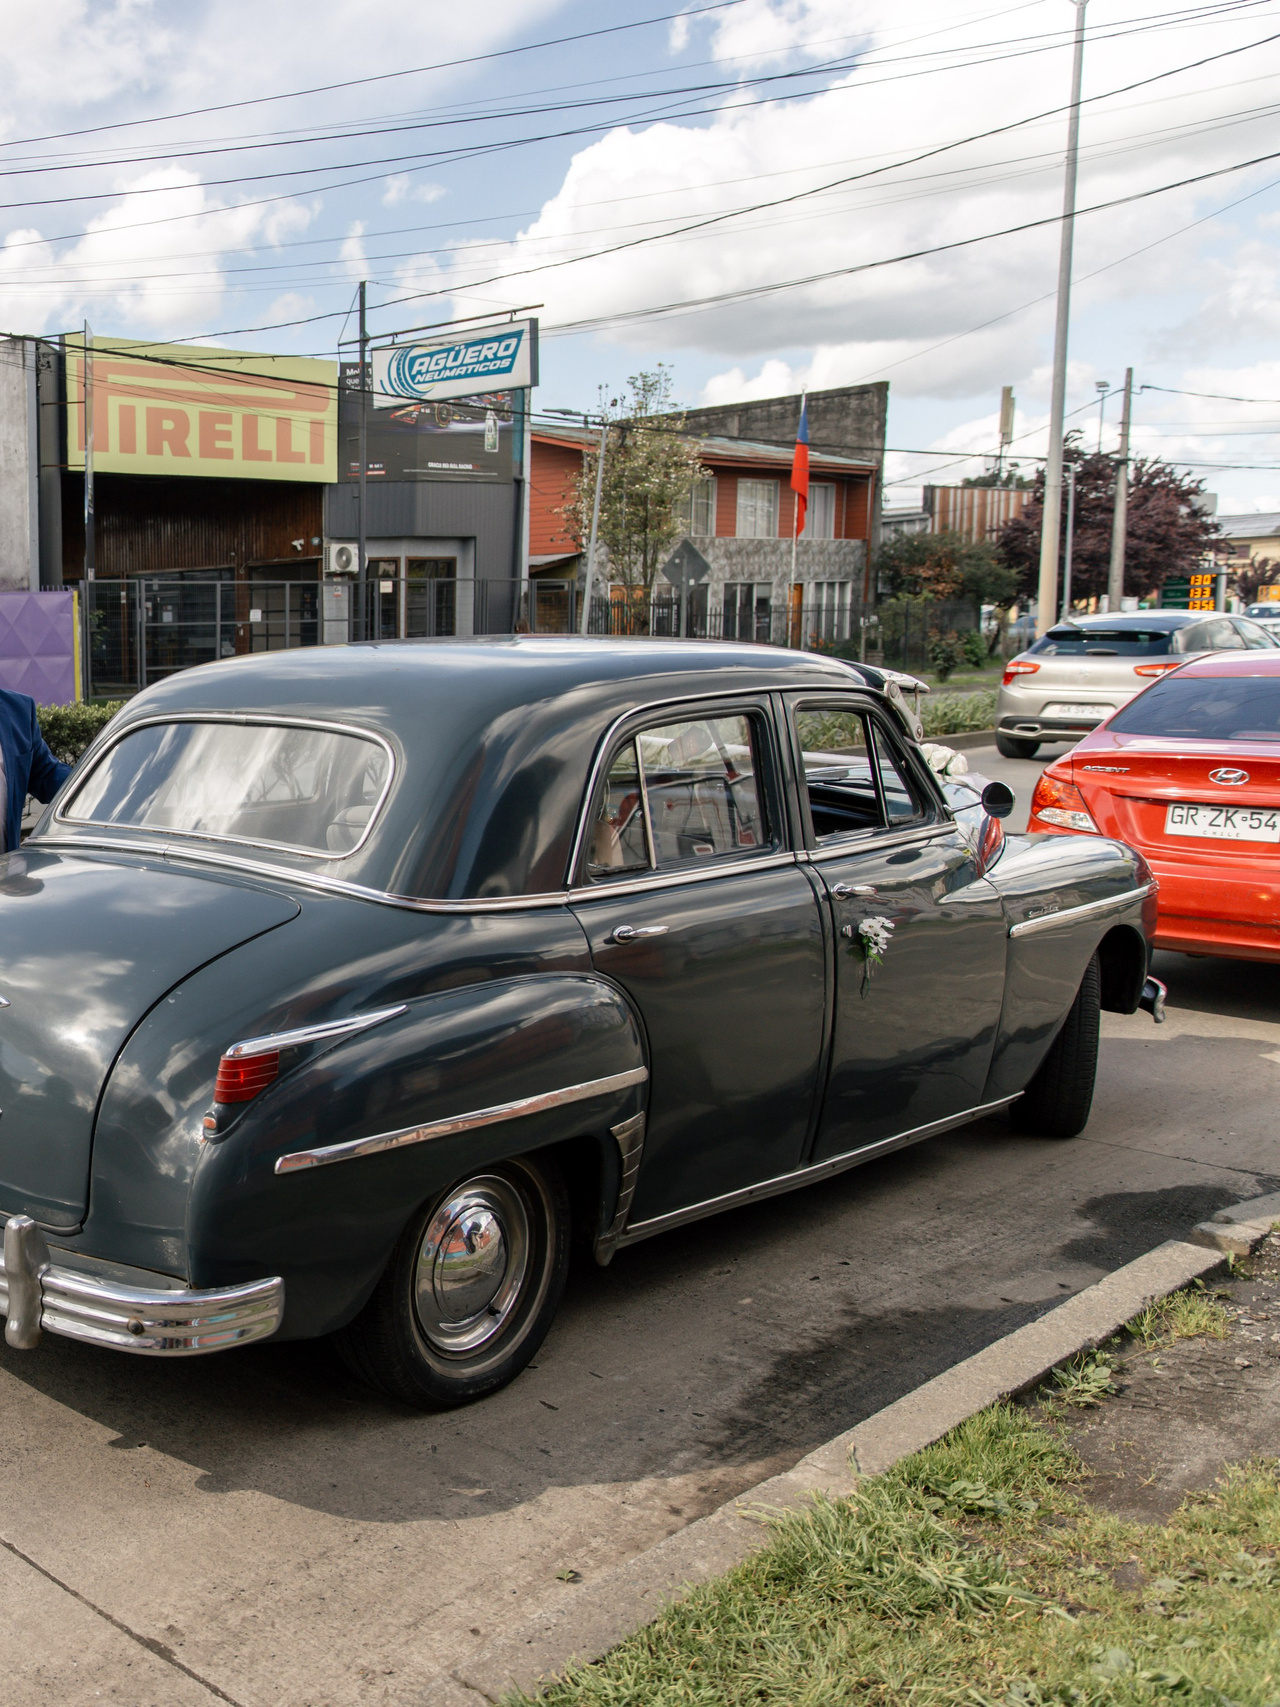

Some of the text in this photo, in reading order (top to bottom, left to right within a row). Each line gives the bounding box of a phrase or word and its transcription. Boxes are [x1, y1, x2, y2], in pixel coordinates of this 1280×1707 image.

[411, 337, 518, 376] AGÜERO
[414, 358, 512, 384] NEUMATICOS
[76, 358, 330, 465] PIRELLI
[1082, 765, 1131, 774] ACCENT
[1203, 830, 1240, 838] CHILE
